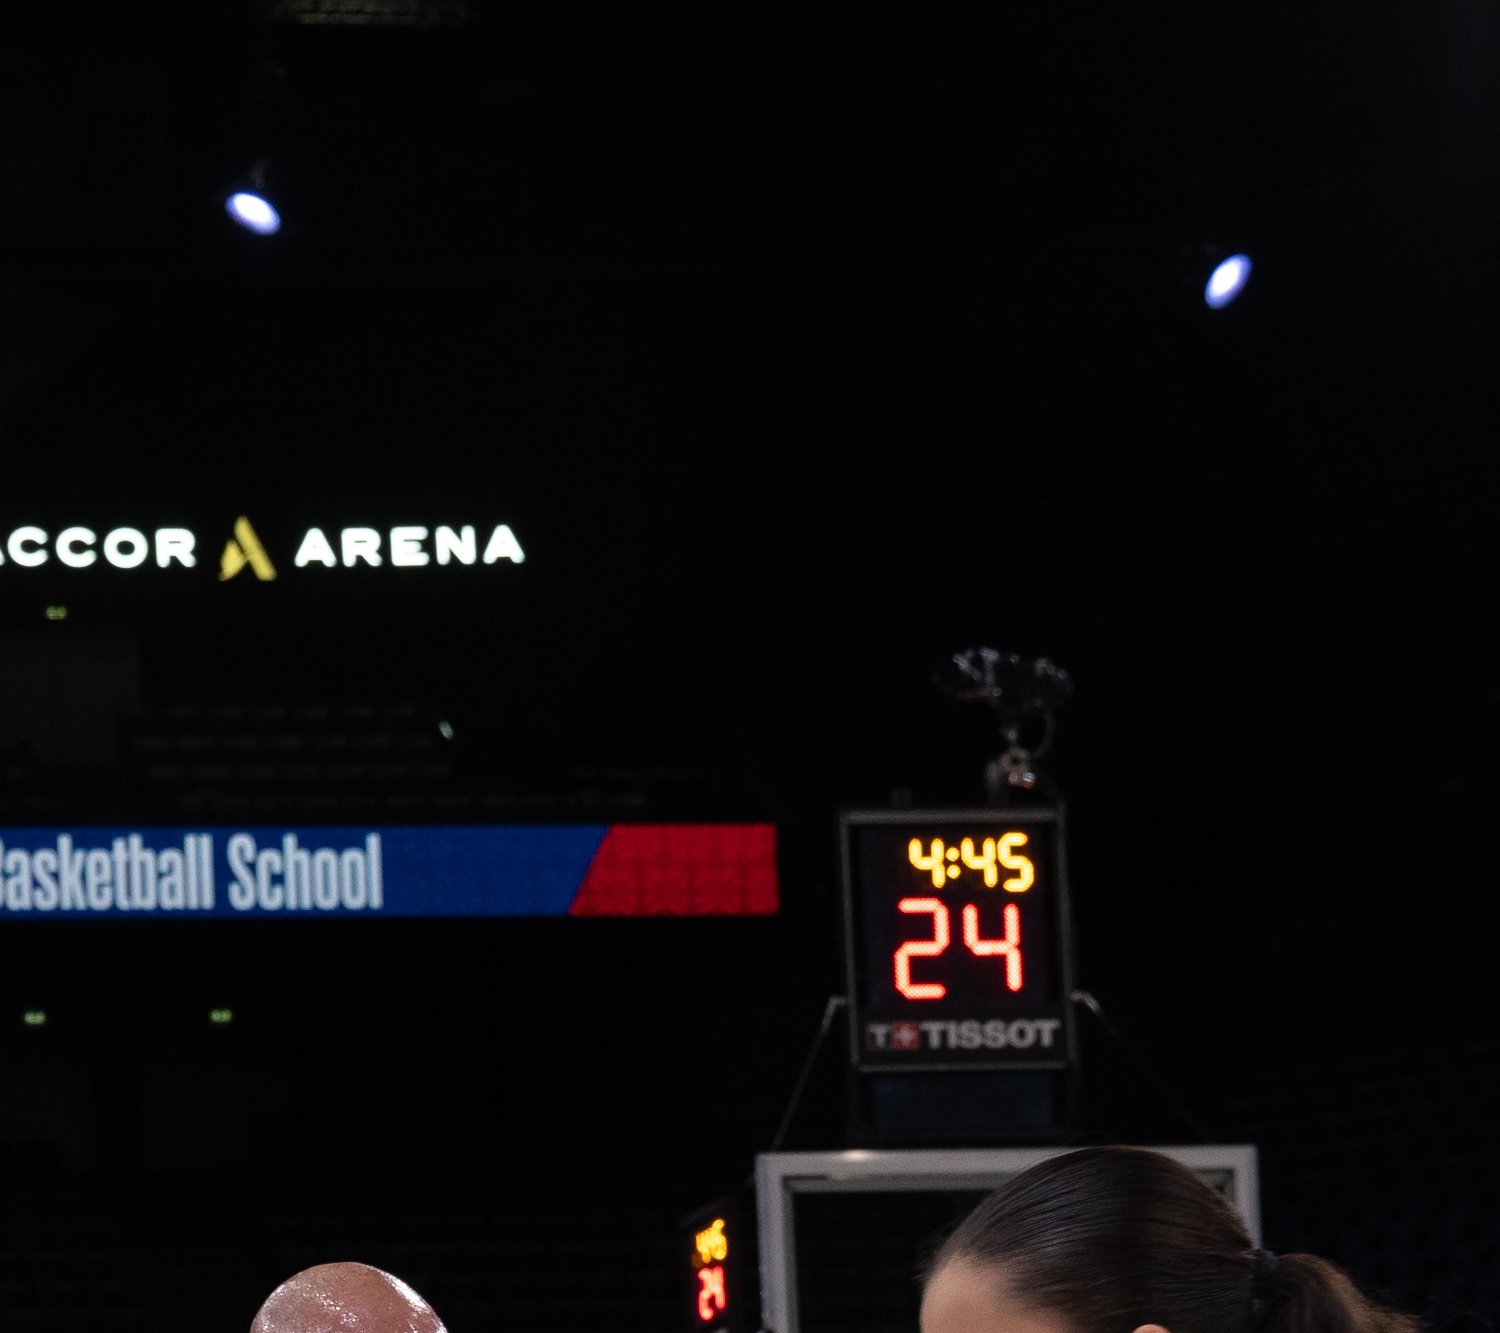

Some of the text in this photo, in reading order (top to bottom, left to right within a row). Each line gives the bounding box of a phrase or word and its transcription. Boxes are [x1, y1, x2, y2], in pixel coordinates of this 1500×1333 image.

[293, 524, 526, 568] ARENA
[227, 833, 384, 911] School
[908, 832, 1035, 893] 4:45
[894, 897, 1023, 999] 24
[920, 1020, 1060, 1049] TISSOT
